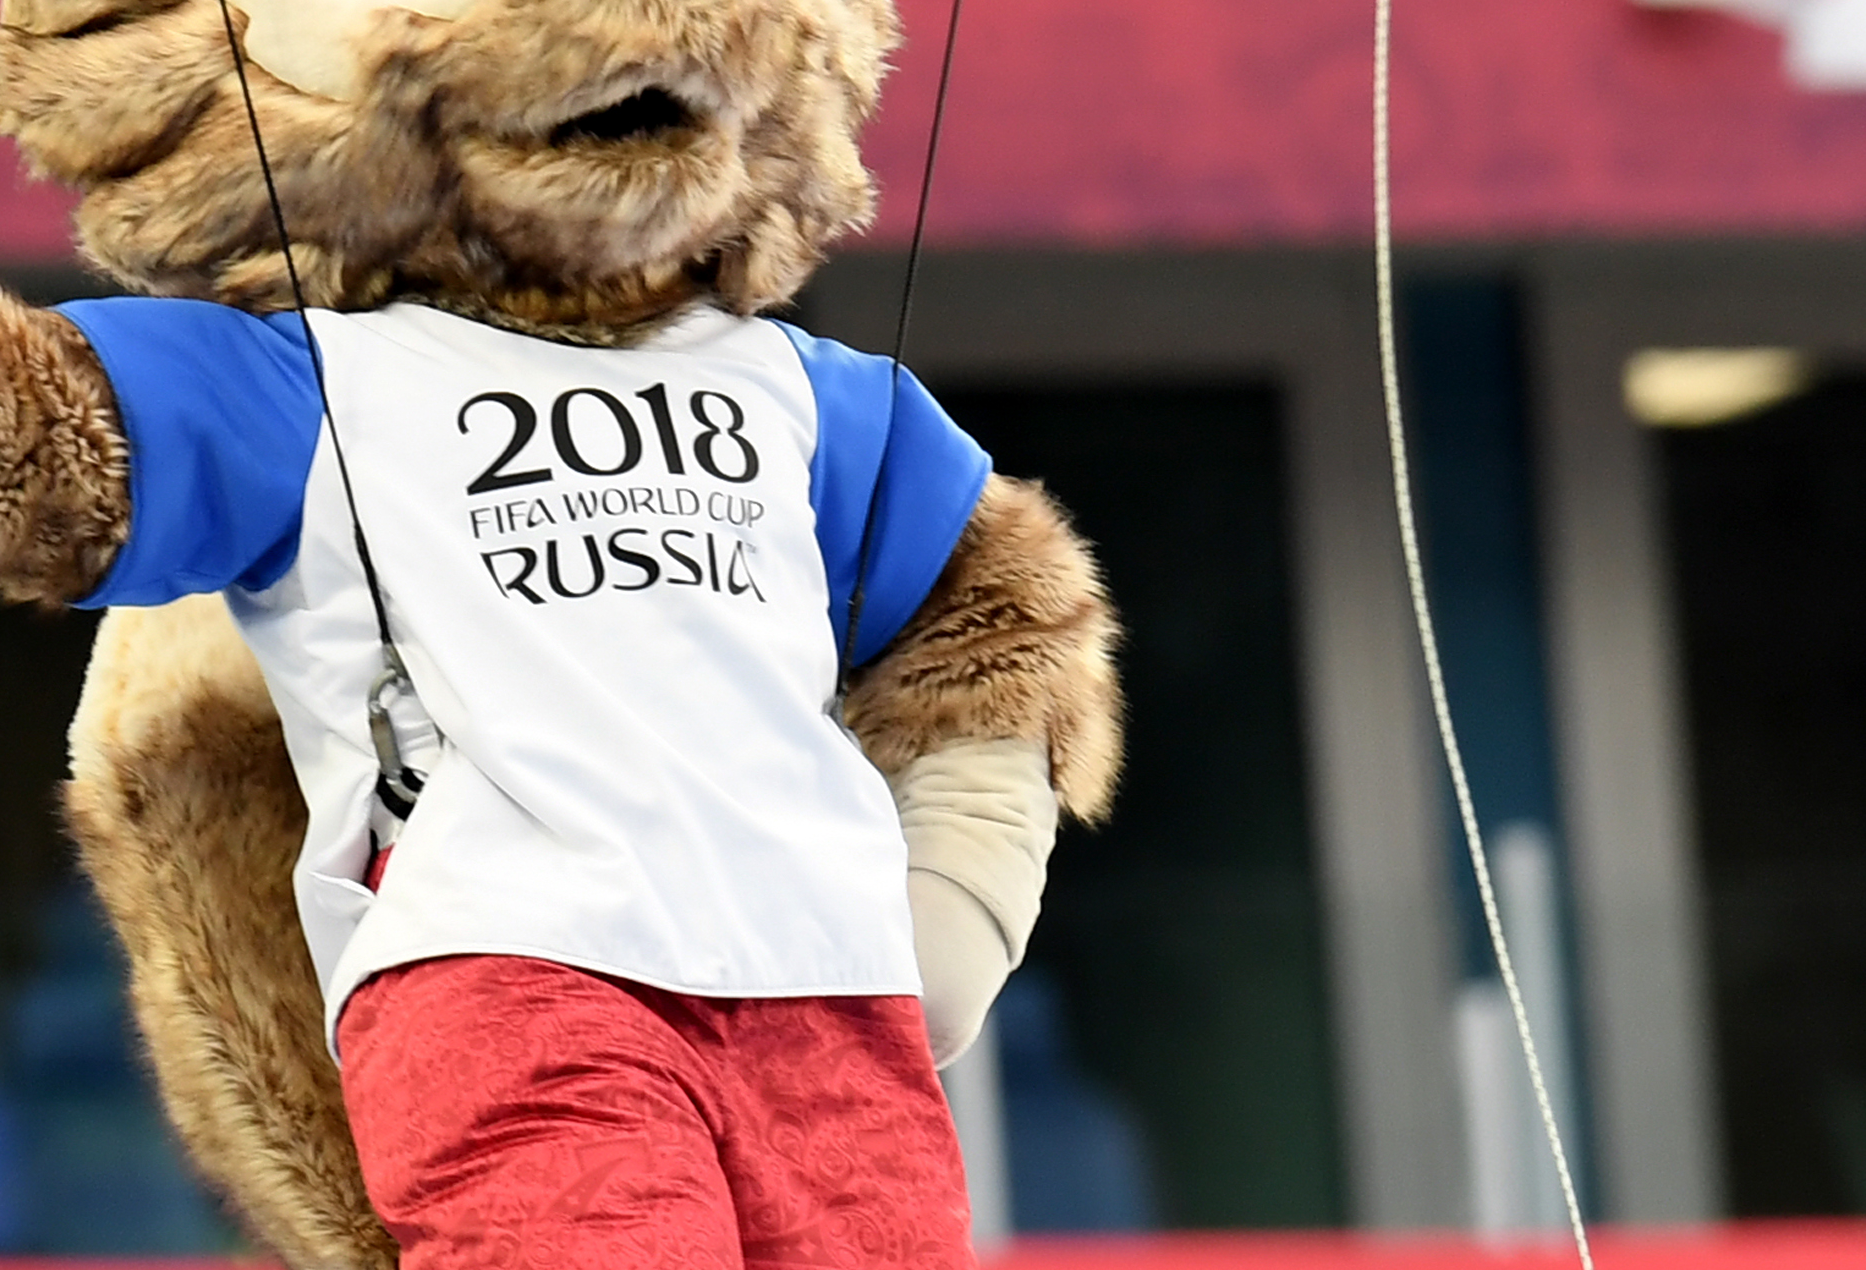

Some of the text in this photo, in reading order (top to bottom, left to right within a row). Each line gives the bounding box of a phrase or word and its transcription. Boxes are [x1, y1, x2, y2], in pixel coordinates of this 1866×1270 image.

[456, 382, 760, 496] 2018
[467, 486, 765, 540] FIFA WORLD CUP
[480, 527, 767, 606] RUSSIA
